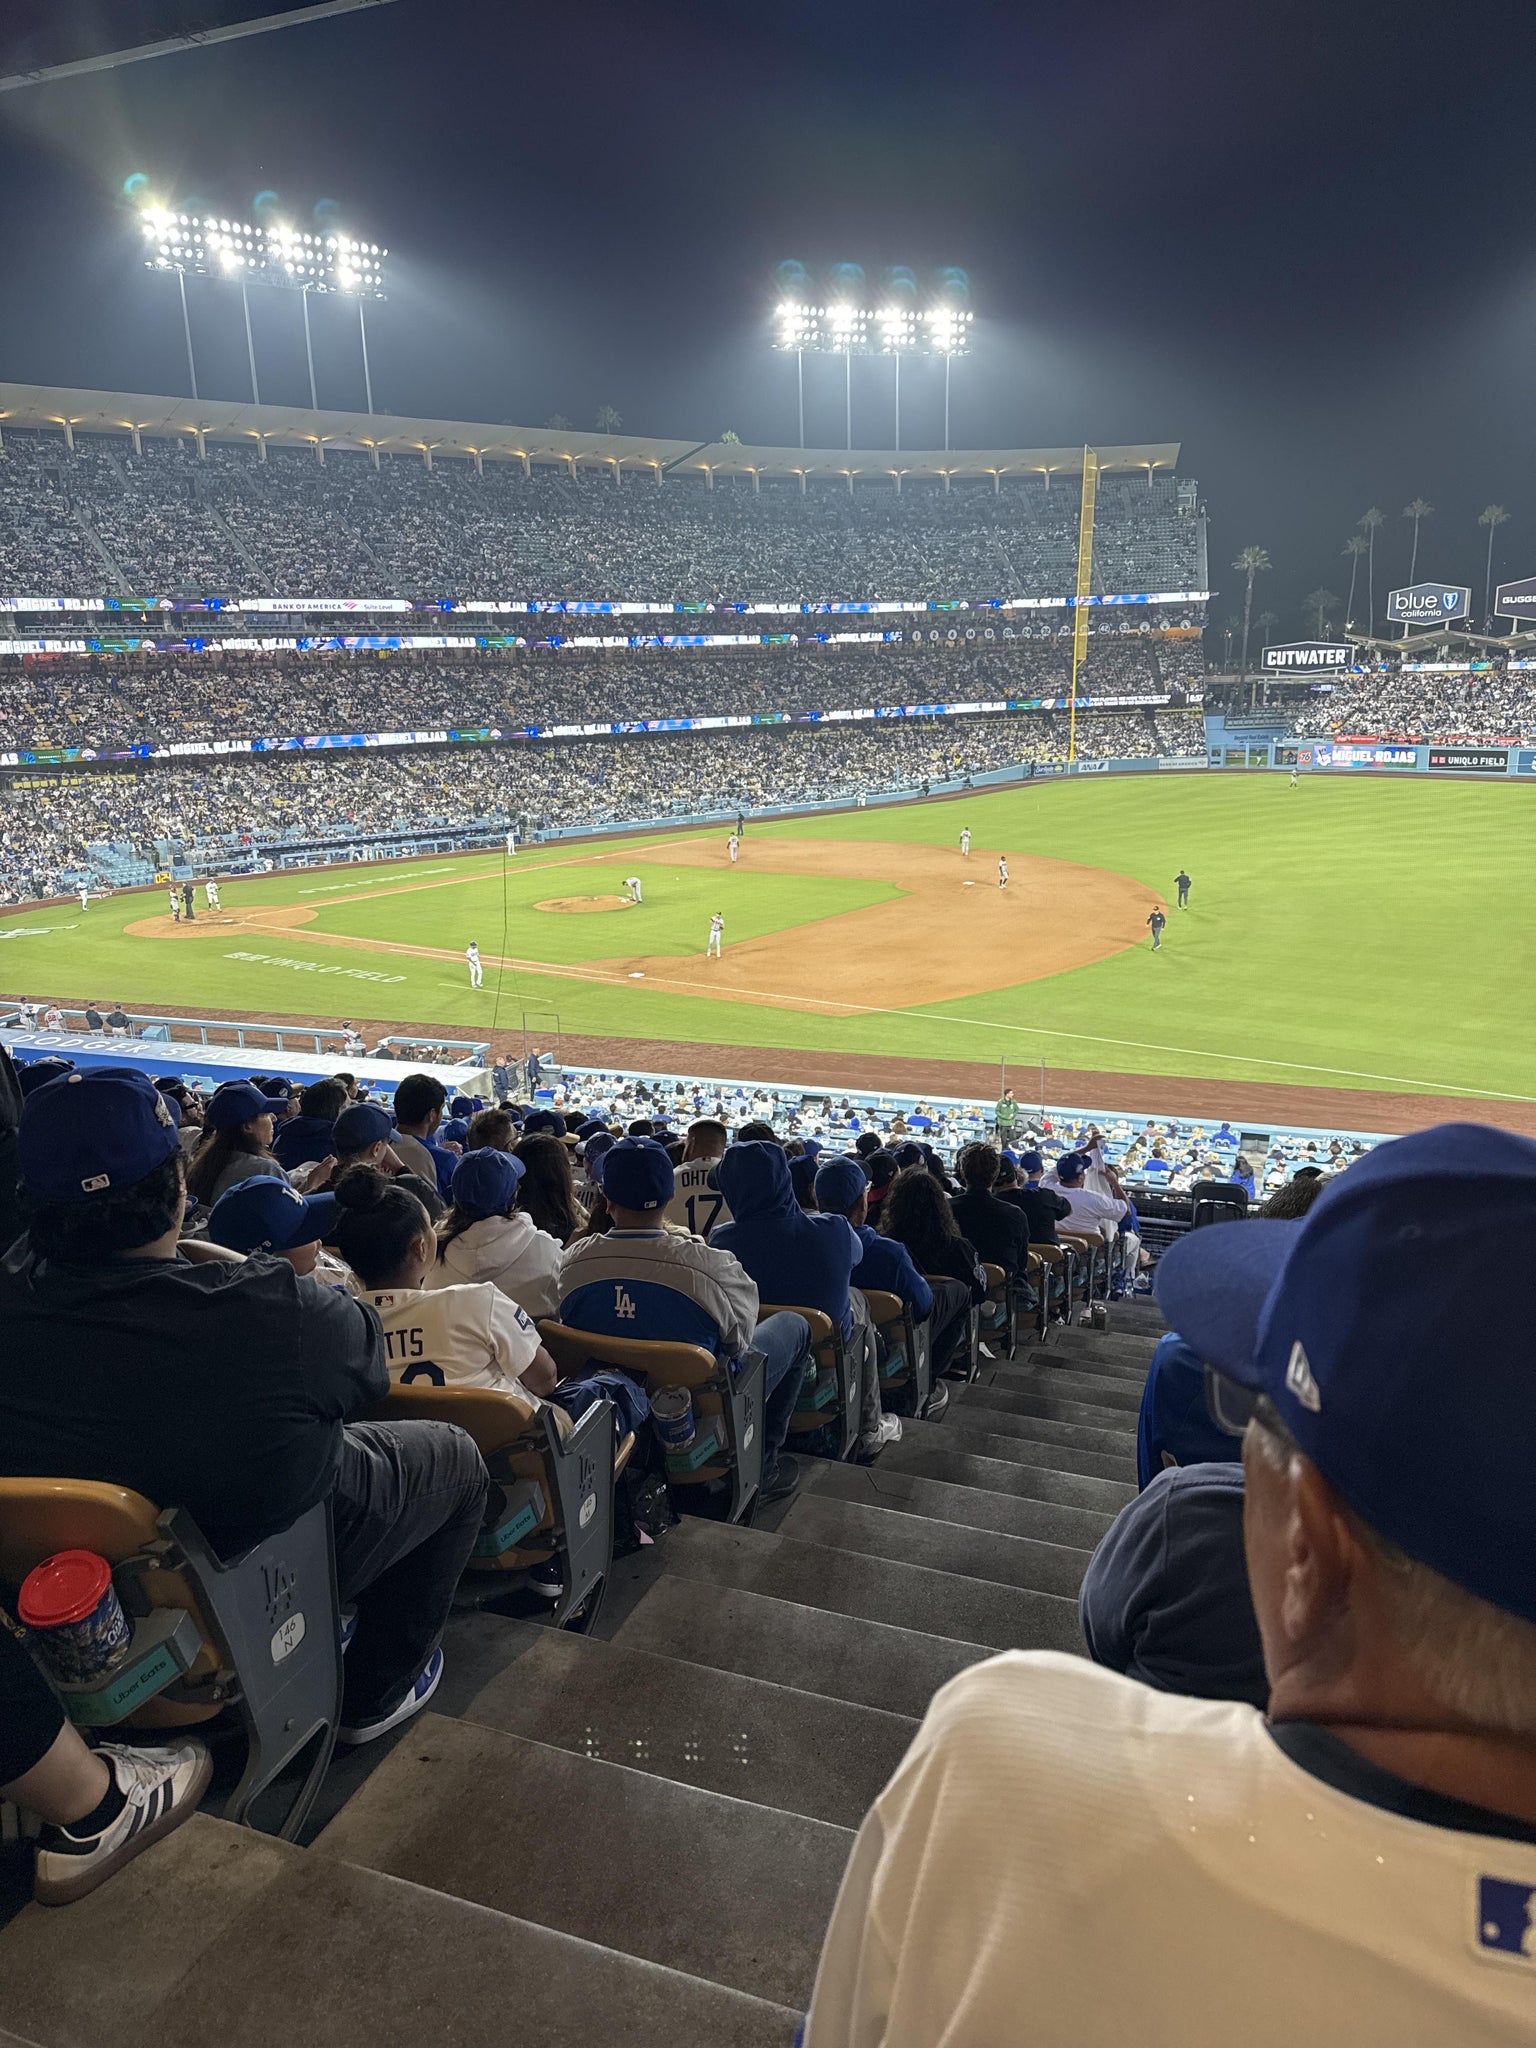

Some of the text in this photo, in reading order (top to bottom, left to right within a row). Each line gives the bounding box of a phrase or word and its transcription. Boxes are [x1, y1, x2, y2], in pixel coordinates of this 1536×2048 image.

[64, 598, 105, 611] ROJAS
[1395, 592, 1438, 610] blue
[1400, 609, 1442, 618] california
[1267, 649, 1346, 666] CUTWATER
[1300, 753, 1310, 761] 76
[1331, 749, 1374, 762] MIGUEL
[1374, 750, 1416, 763] ROJAS
[1447, 756, 1479, 765] UNIQLO
[1480, 757, 1505, 766] FIELD
[1081, 761, 1098, 771] ANA
[263, 957, 408, 983] UNIQLO FIELD
[47, 1014, 57, 1022] 22
[9, 1034, 151, 1054] DODGER
[681, 1169, 709, 1188] OHT
[685, 1194, 723, 1237] 17
[614, 1285, 636, 1319] LA
[384, 1327, 423, 1360] TTS
[501, 1514, 531, 1543] Uber Eats
[278, 1619, 297, 1641] 146
[284, 1636, 294, 1652] N
[113, 1660, 167, 1705] Uber Eats
